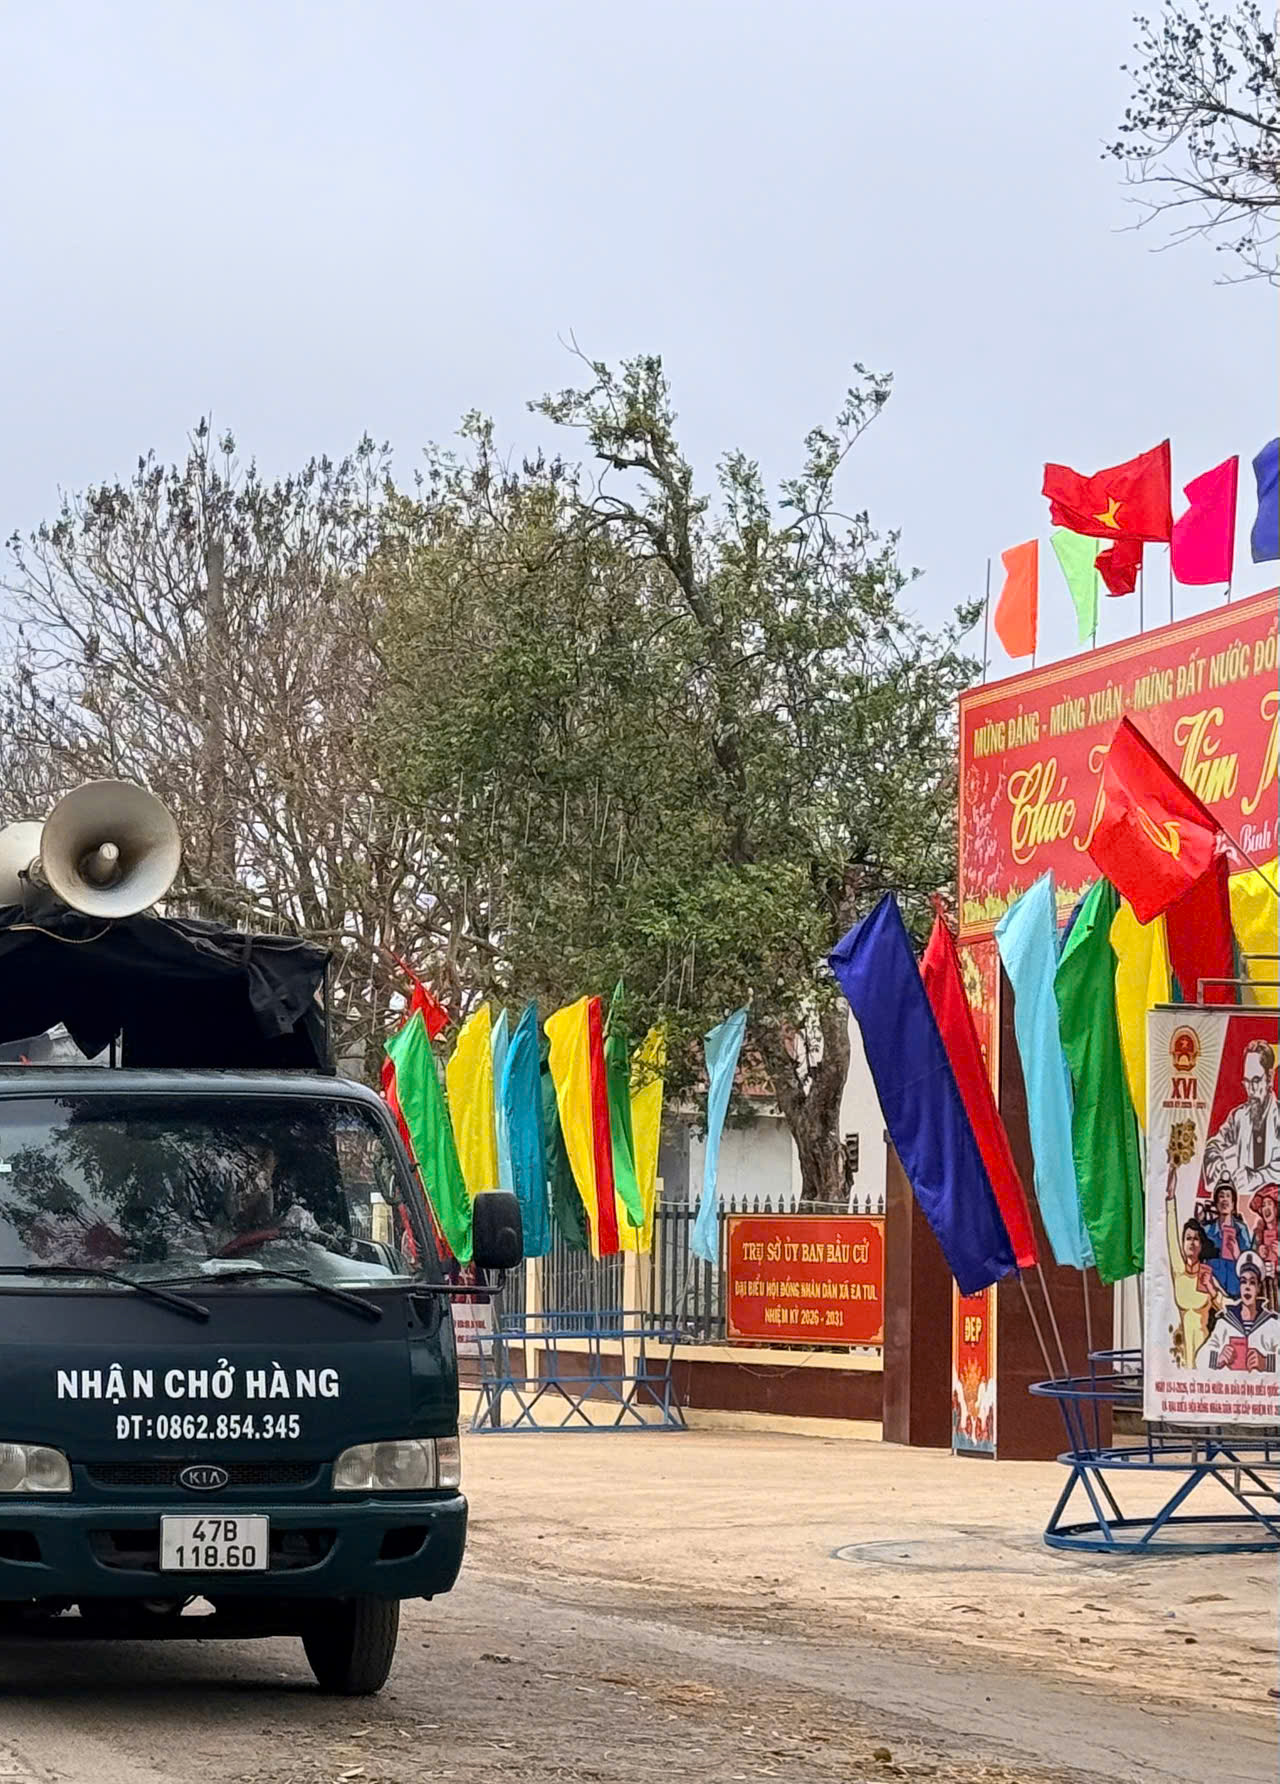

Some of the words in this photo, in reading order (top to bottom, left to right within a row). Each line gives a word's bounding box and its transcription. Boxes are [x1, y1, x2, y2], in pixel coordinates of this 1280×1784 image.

[973, 717, 1006, 759] MỪNG
[1008, 703, 1040, 750] ĐẢNG
[1050, 695, 1086, 737] MỪNG
[1087, 680, 1123, 727] XUÂN
[1134, 666, 1174, 711] MỪNG
[1176, 647, 1207, 699] ĐẤT
[1209, 638, 1251, 689] NƯỚC
[1007, 757, 1076, 865] Chúc
[1171, 1077, 1197, 1100] XVI
[801, 1243, 824, 1263] BAN
[826, 1233, 850, 1263] BẦU
[853, 1237, 870, 1263] CỬ
[57, 1363, 154, 1404] NHẬN
[164, 1358, 236, 1399] CHỞ
[246, 1361, 340, 1399] HÀNG
[116, 1414, 301, 1440] ĐT:0862.854.345
[189, 1471, 221, 1484] KIA
[192, 1520, 238, 1542] 47B
[176, 1545, 256, 1568] 118.60
